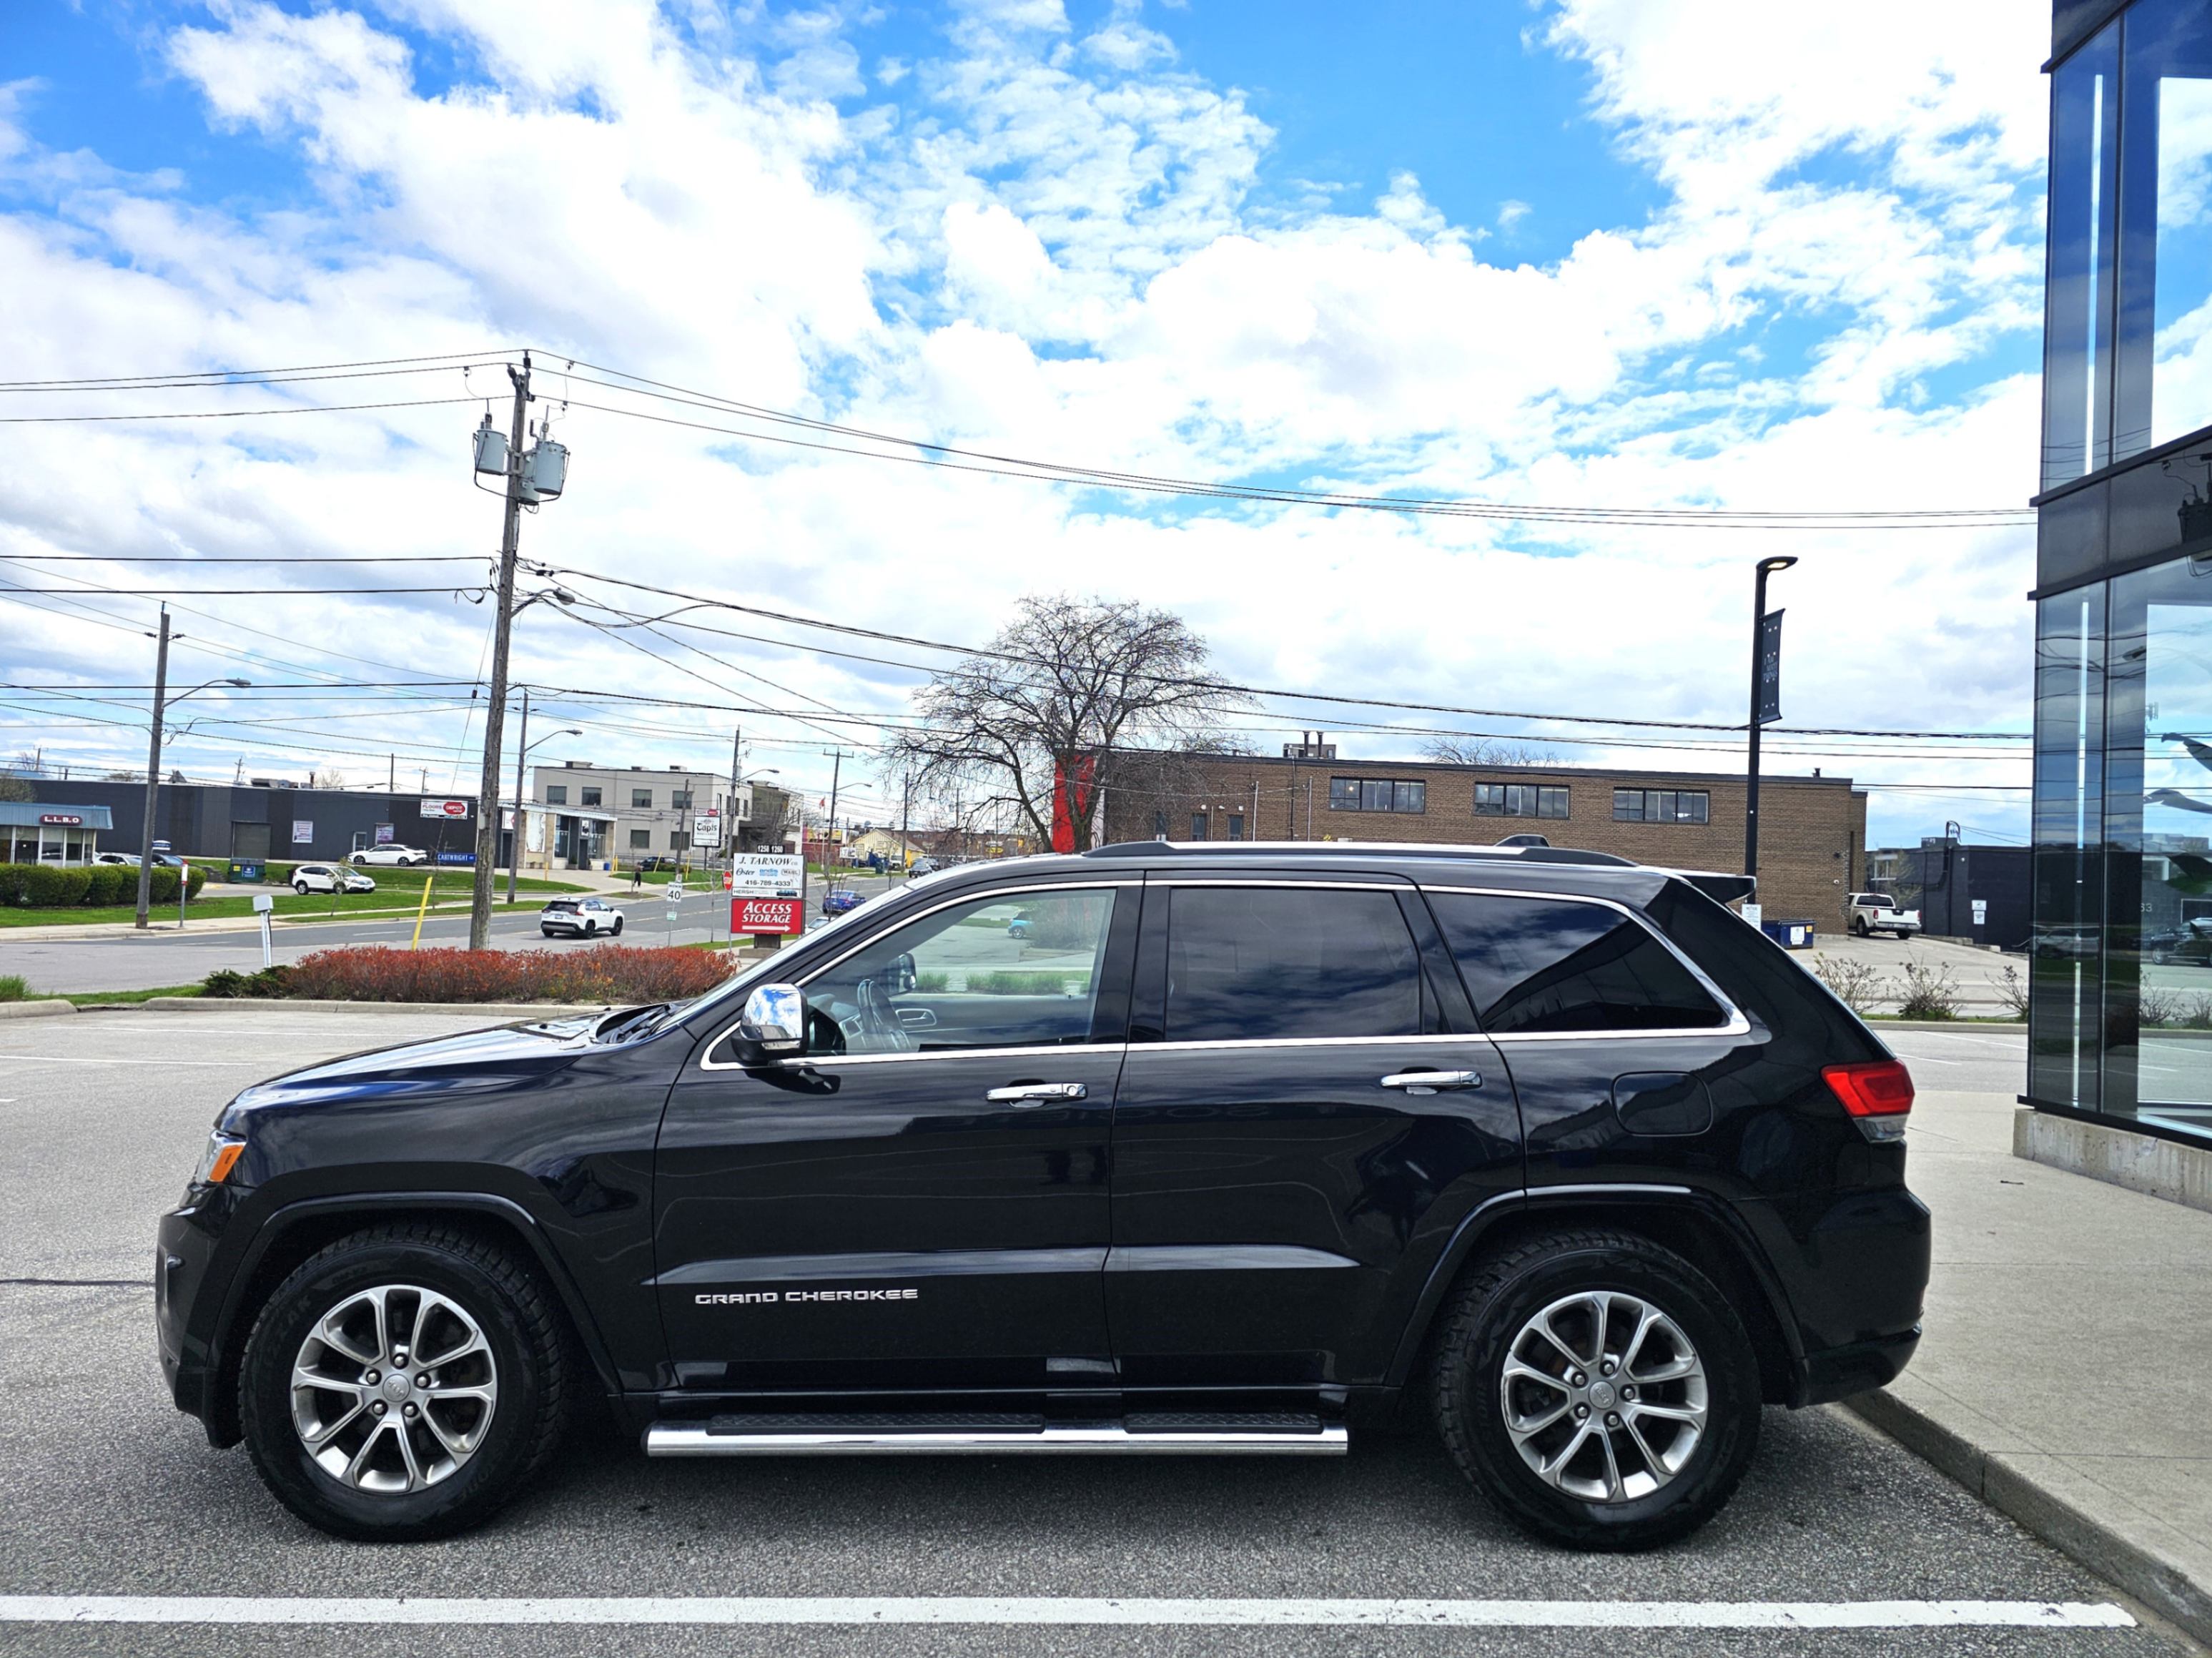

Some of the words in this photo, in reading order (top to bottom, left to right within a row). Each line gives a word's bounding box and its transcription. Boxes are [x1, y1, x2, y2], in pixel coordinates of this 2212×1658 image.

[749, 857, 791, 866] TARNOW
[736, 867, 755, 876] Oster
[668, 890, 681, 900] 40
[742, 902, 792, 914] ACCESS
[742, 914, 791, 924] STORAGE
[695, 1293, 779, 1305] GRAND
[785, 1288, 919, 1302] CHEROKEE
